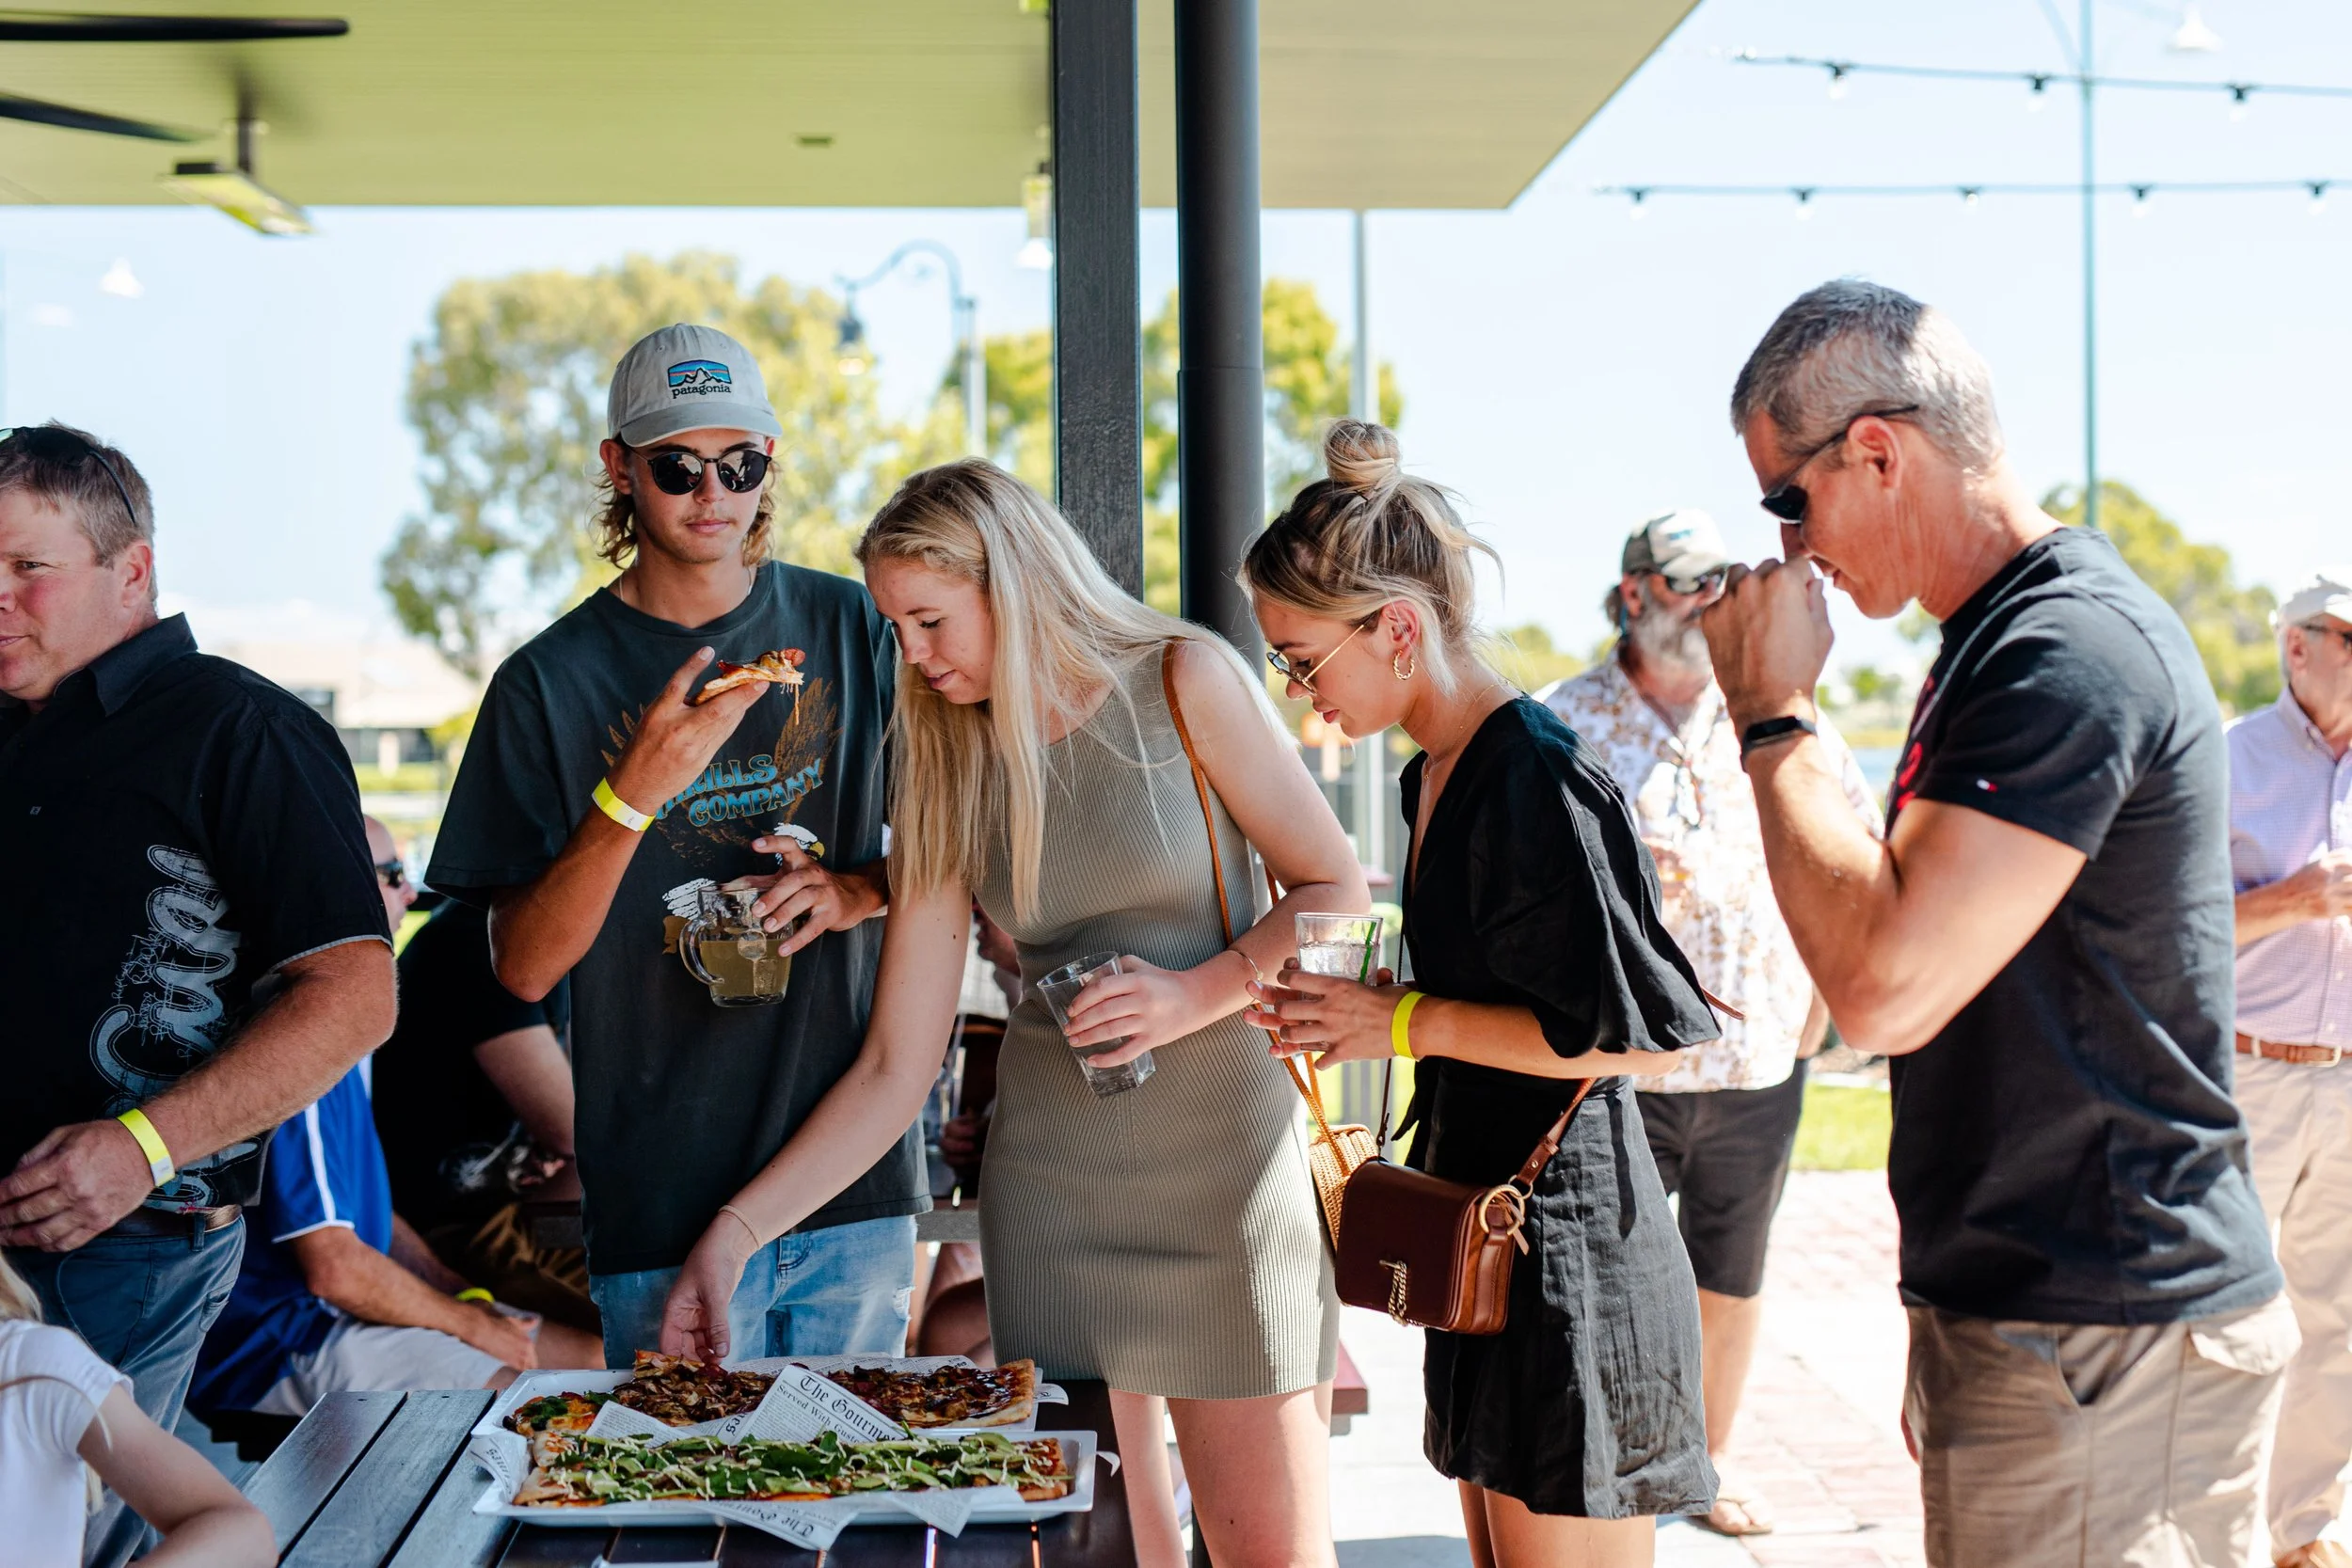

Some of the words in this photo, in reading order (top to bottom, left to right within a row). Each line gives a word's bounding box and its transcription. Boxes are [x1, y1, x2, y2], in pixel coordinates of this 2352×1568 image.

[672, 384, 732, 399] patagonia
[656, 754, 778, 820] ILLS
[689, 758, 824, 828] COMPANY
[777, 1385, 809, 1410] Served
[811, 1406, 832, 1427] With
[800, 1375, 829, 1402] The
[832, 1399, 896, 1441] Gourm
[781, 1516, 815, 1537] The
